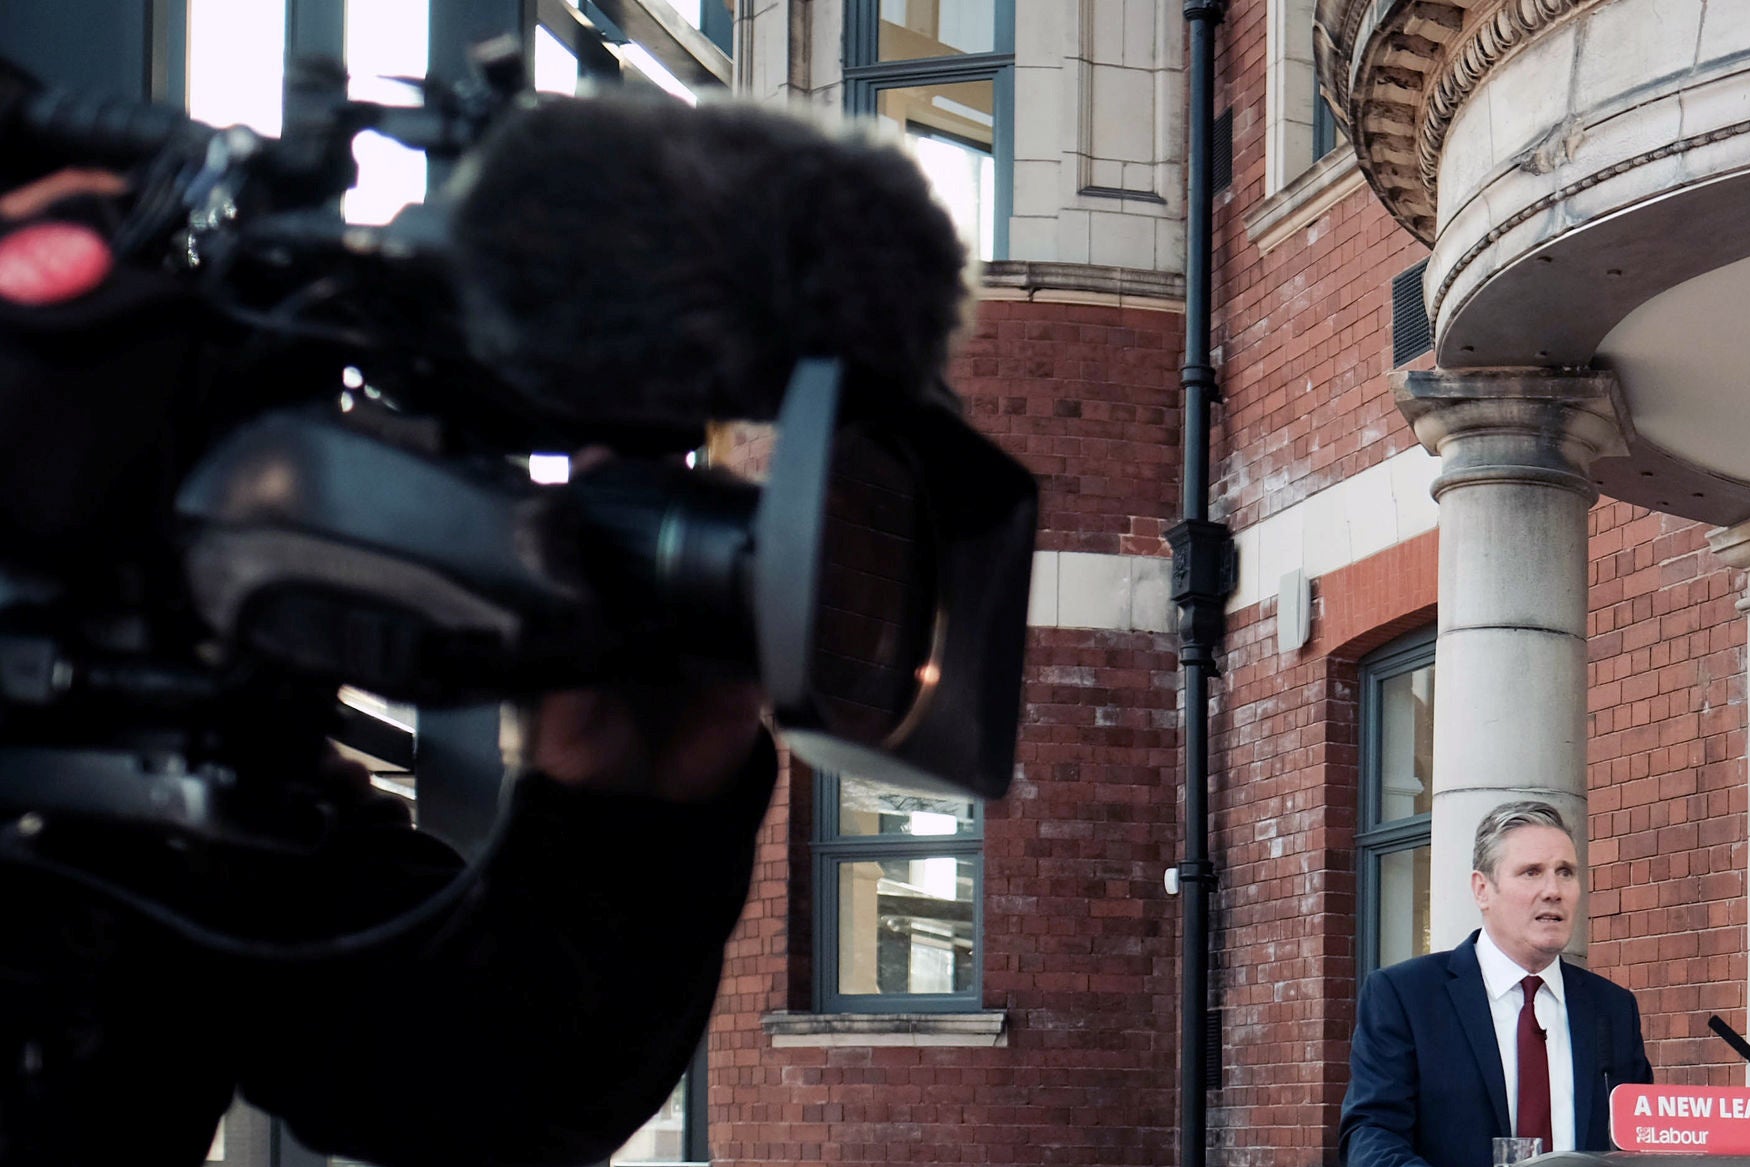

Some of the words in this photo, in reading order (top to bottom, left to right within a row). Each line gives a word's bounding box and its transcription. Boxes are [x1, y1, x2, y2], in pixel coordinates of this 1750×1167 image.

[1634, 1095, 1652, 1116] A
[1658, 1096, 1712, 1117] NEW
[1651, 1127, 1709, 1145] Labour
